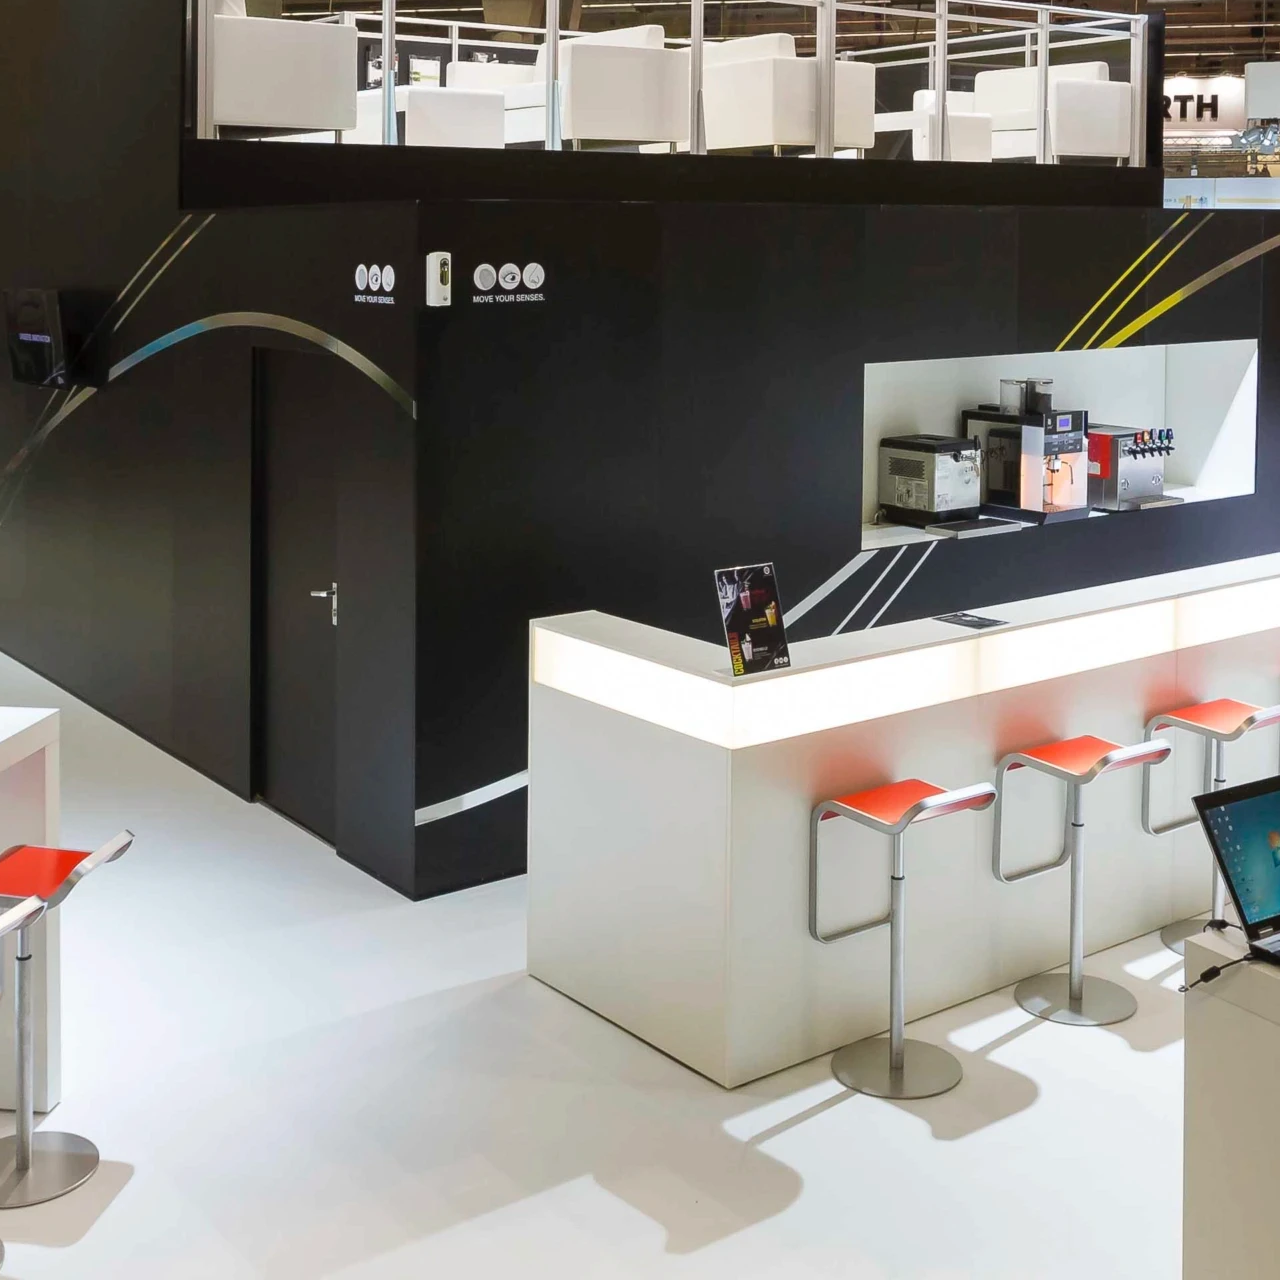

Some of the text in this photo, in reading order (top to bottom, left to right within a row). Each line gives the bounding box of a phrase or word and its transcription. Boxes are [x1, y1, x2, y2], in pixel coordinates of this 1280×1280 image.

[473, 293, 545, 303] MOVE YOUR SENSES.
